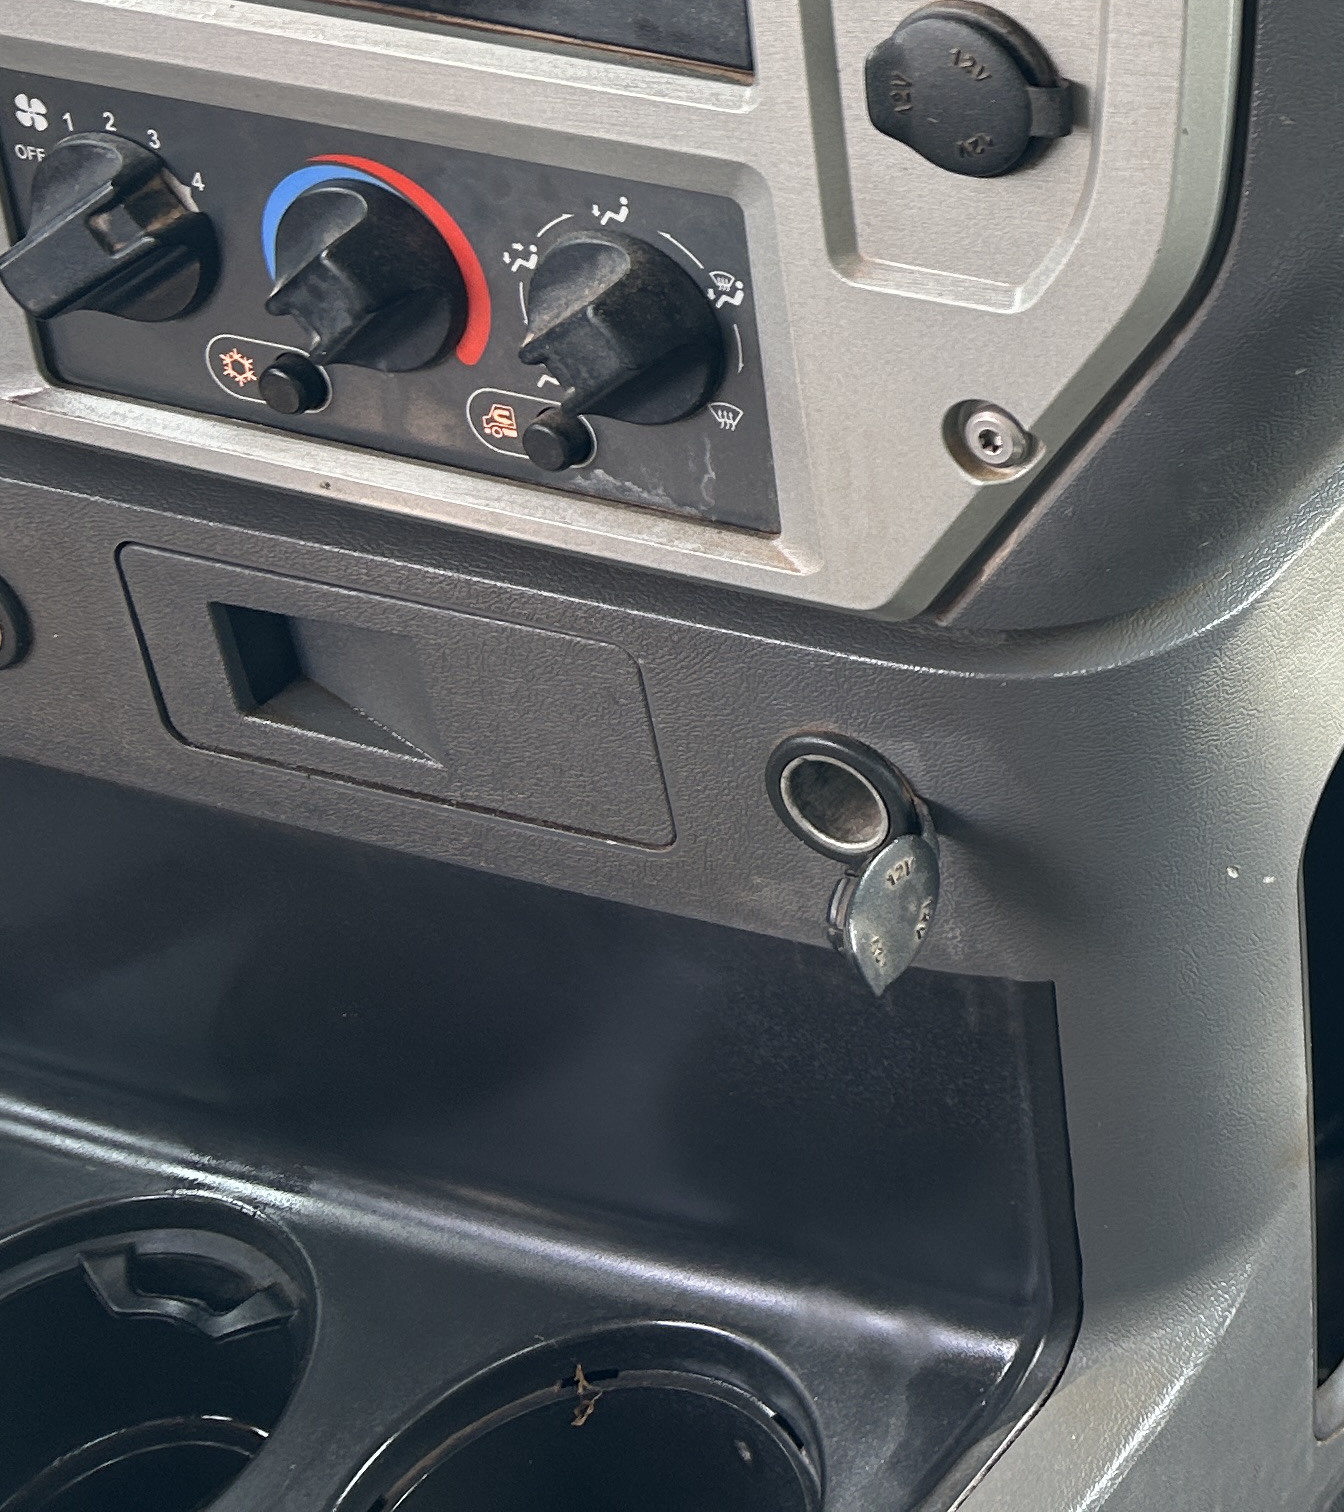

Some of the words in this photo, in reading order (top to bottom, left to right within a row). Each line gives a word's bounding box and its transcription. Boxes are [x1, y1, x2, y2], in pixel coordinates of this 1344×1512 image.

[948, 47, 993, 82] 12V
[62, 112, 75, 132] 1
[102, 111, 118, 132] 2
[146, 128, 162, 149] 3
[14, 143, 46, 163] OFF
[191, 171, 206, 192] 4
[885, 856, 917, 888] 12V
